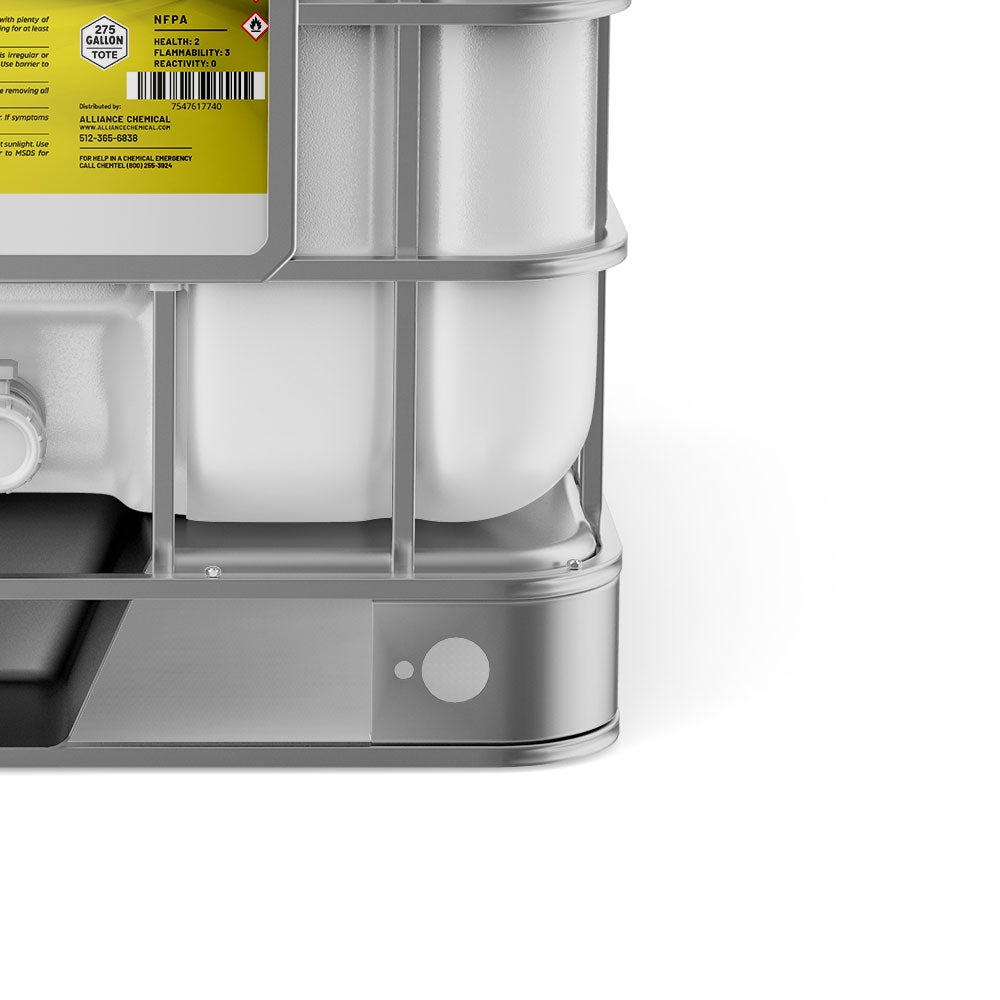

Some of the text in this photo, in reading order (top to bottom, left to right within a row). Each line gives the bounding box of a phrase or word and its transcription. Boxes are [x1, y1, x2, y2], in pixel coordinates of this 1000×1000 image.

[17, 16, 39, 24] plenty
[154, 14, 188, 25] NFPA
[94, 25, 116, 35] 275
[86, 35, 124, 45] GALLON
[154, 38, 200, 46] HEALTH: 2
[8, 52, 38, 60] irregular
[92, 50, 118, 59] TOTE
[154, 48, 230, 57] FLAMMABILITY: 3
[154, 59, 217, 68] REACTIVITY: 0
[5, 87, 38, 95] removing
[112, 103, 121, 111] by:
[171, 102, 222, 111] 7547617740
[11, 114, 49, 122] symptoms
[79, 115, 171, 123] ALLIANCE CHEMICAL
[79, 134, 138, 143] 512-365-6838
[4, 141, 35, 149] sunlight.
